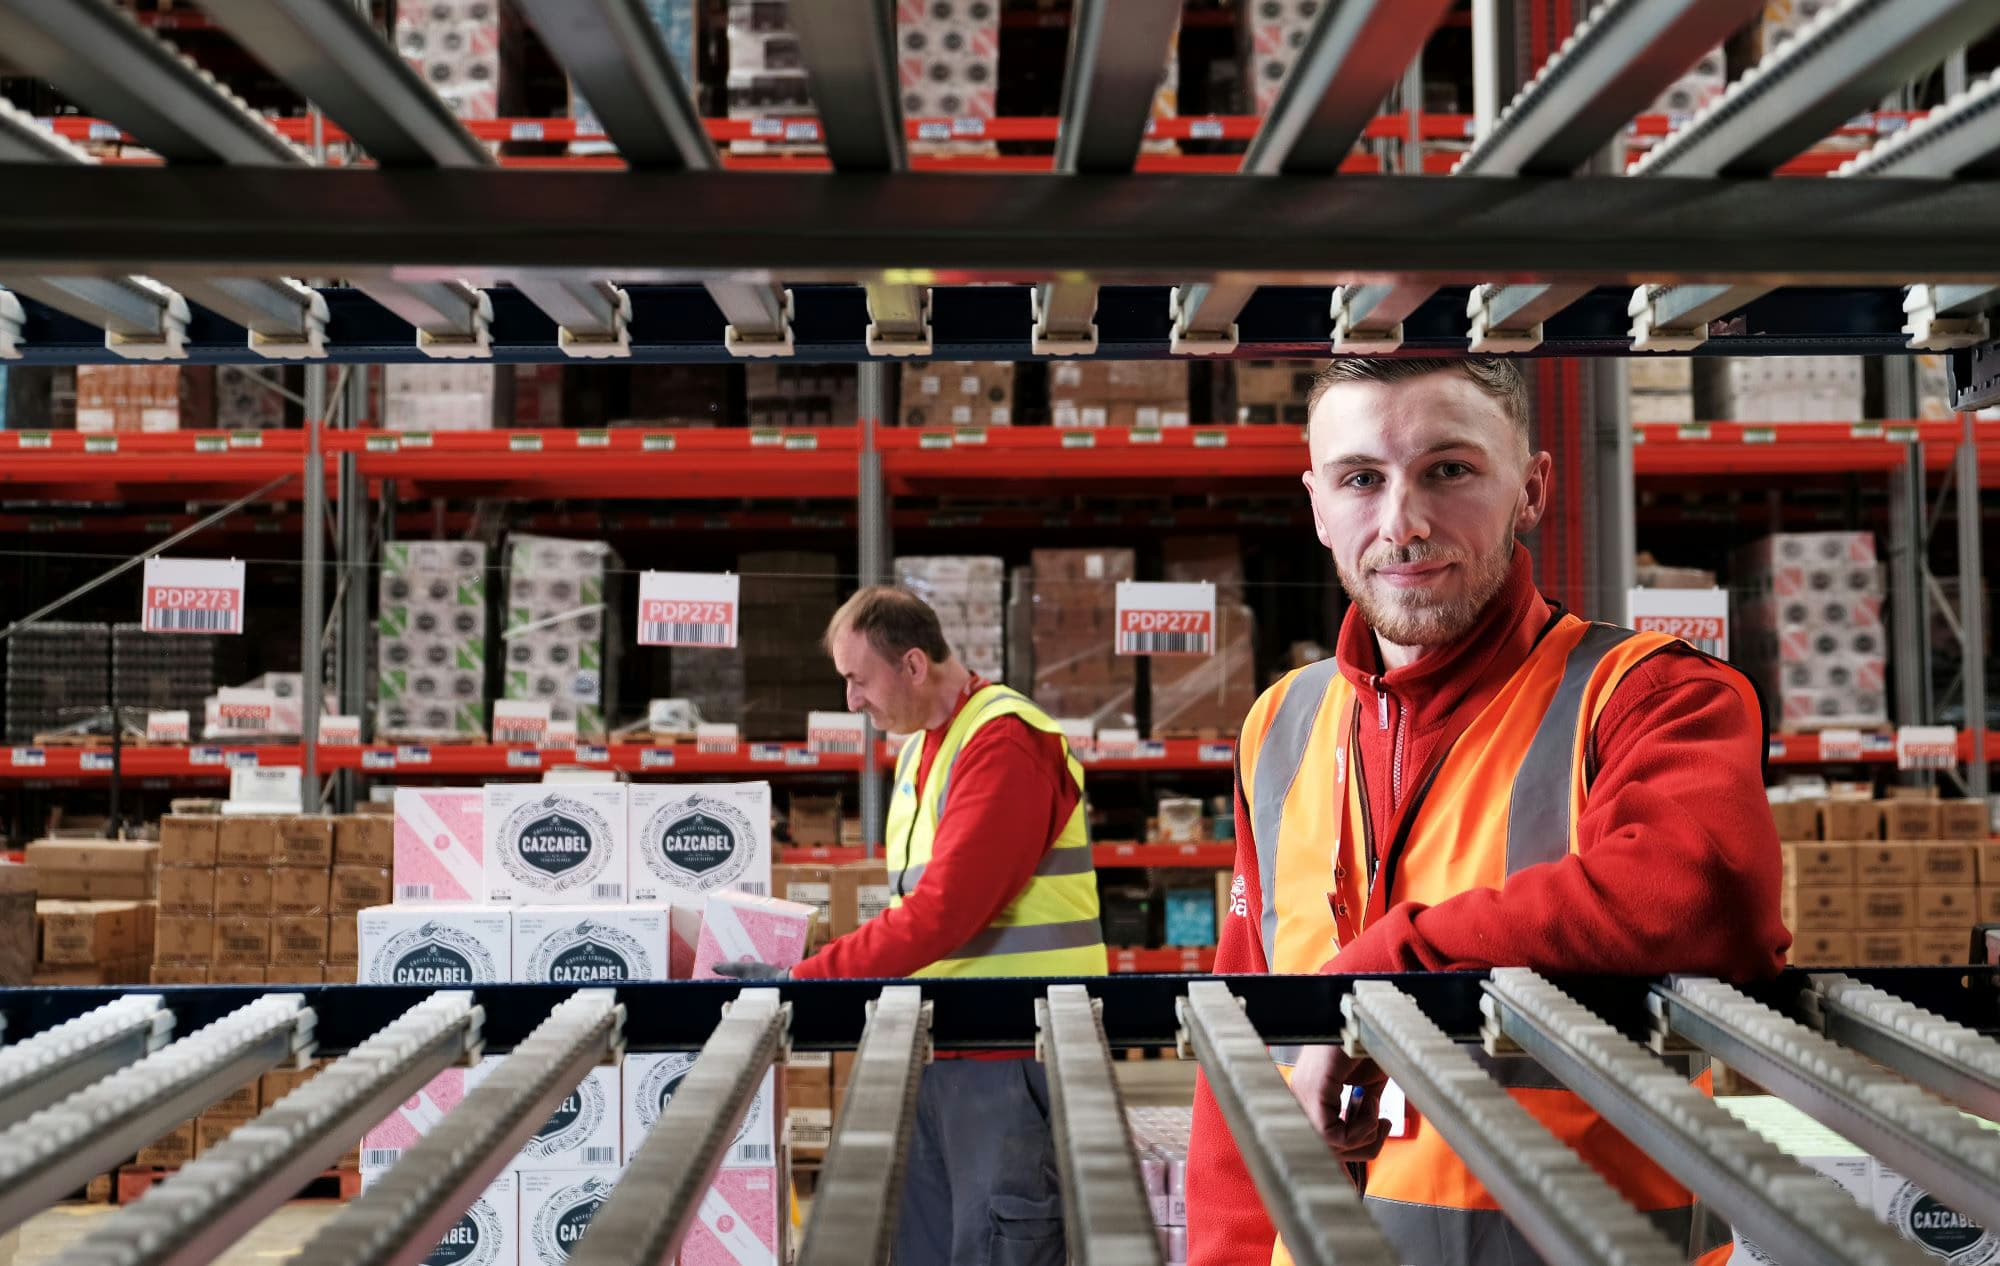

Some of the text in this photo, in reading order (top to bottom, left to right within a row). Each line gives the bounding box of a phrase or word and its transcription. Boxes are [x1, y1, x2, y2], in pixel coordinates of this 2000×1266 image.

[155, 588, 232, 608] PDP273
[650, 602, 726, 622] PDP275
[1128, 612, 1204, 631] PDP277
[1641, 618, 1718, 639] PDP279
[522, 836, 588, 852] CAZCABEL
[666, 835, 731, 851] CAZCABEL
[397, 966, 469, 984] CAZCABEL
[554, 965, 624, 982] CAZCABEL
